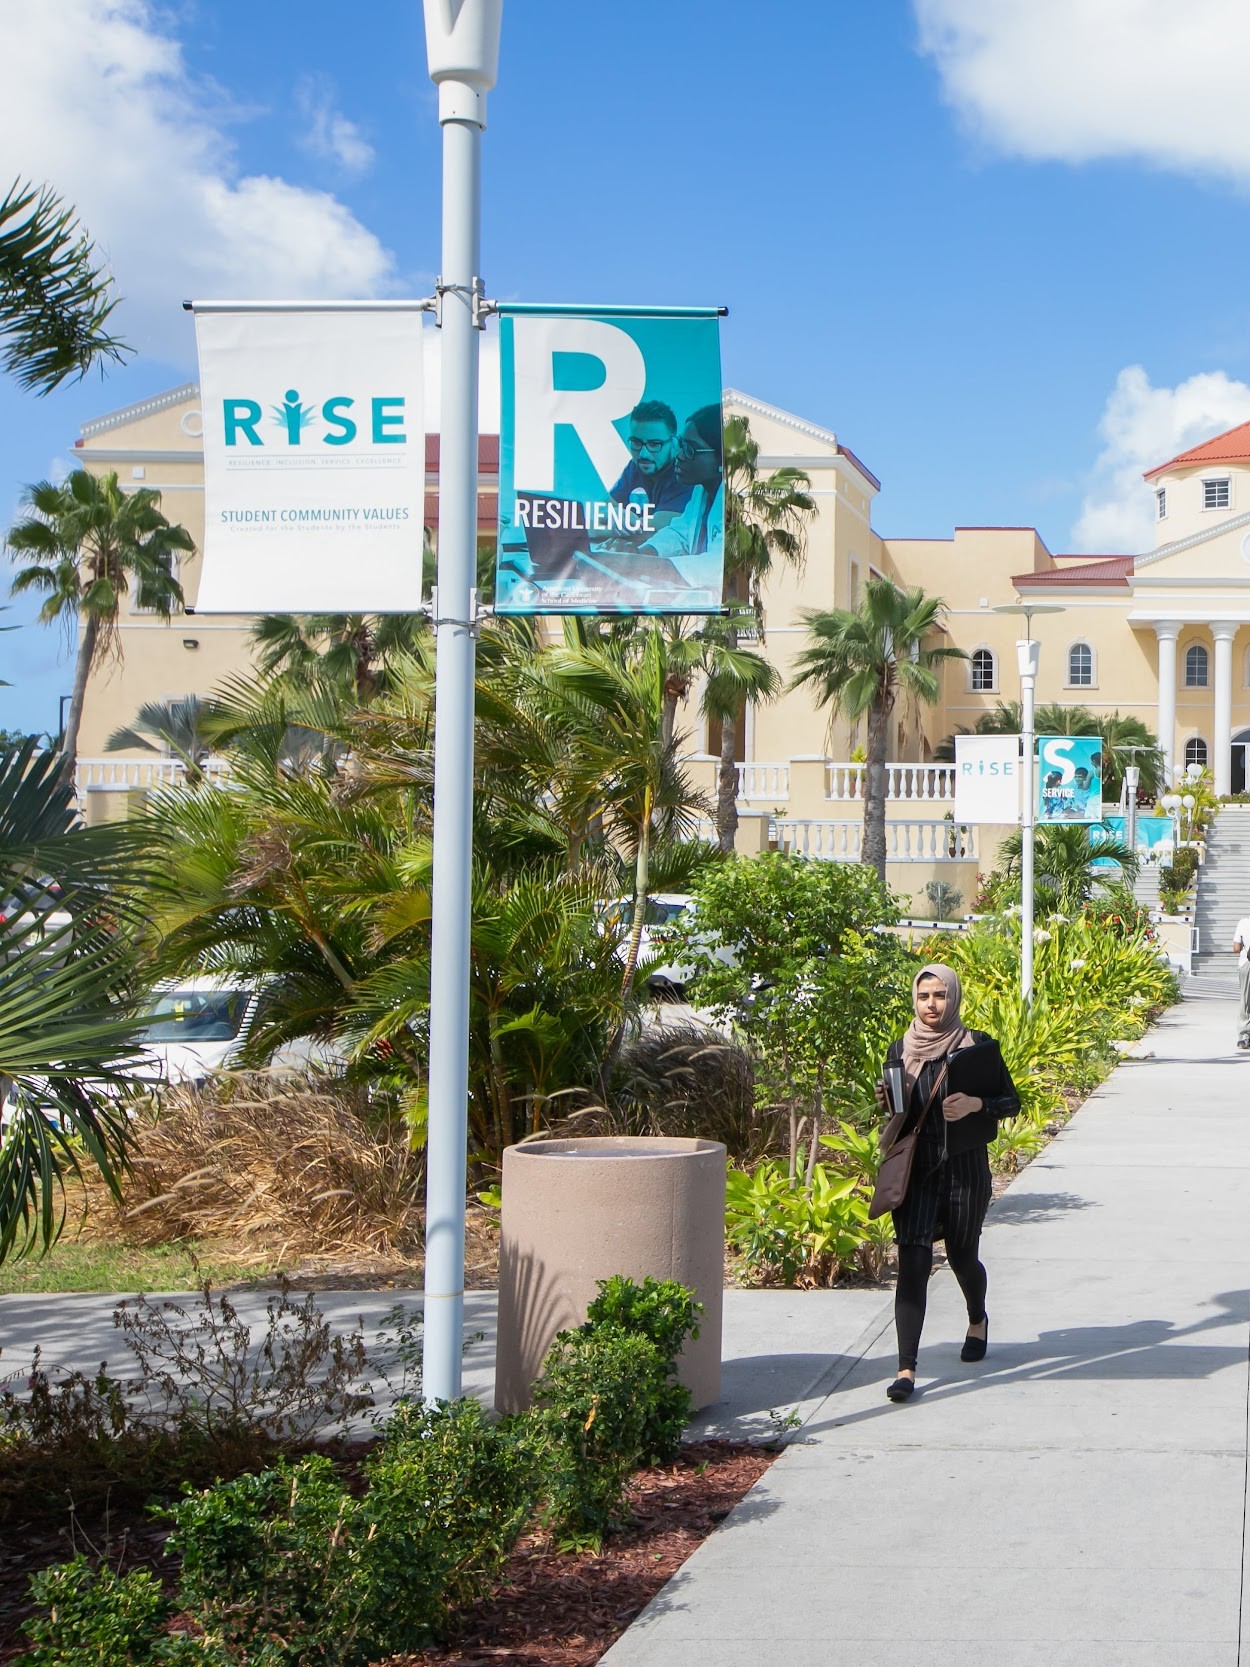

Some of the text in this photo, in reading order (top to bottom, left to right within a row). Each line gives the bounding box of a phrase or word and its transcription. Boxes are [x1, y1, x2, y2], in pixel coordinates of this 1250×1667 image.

[513, 316, 646, 491] R
[222, 389, 407, 446] RISE
[221, 507, 410, 523] STUDENT COMMUNITY VALUES
[514, 498, 656, 532] RESILIENCE
[230, 525, 263, 533] Created
[280, 524, 294, 532] the
[297, 523, 332, 532] Students
[335, 523, 346, 534] by
[348, 523, 362, 532] the
[365, 522, 401, 531] Students
[962, 760, 1013, 776] RISE
[1043, 739, 1076, 785] S
[1042, 787, 1075, 798] SERVICE
